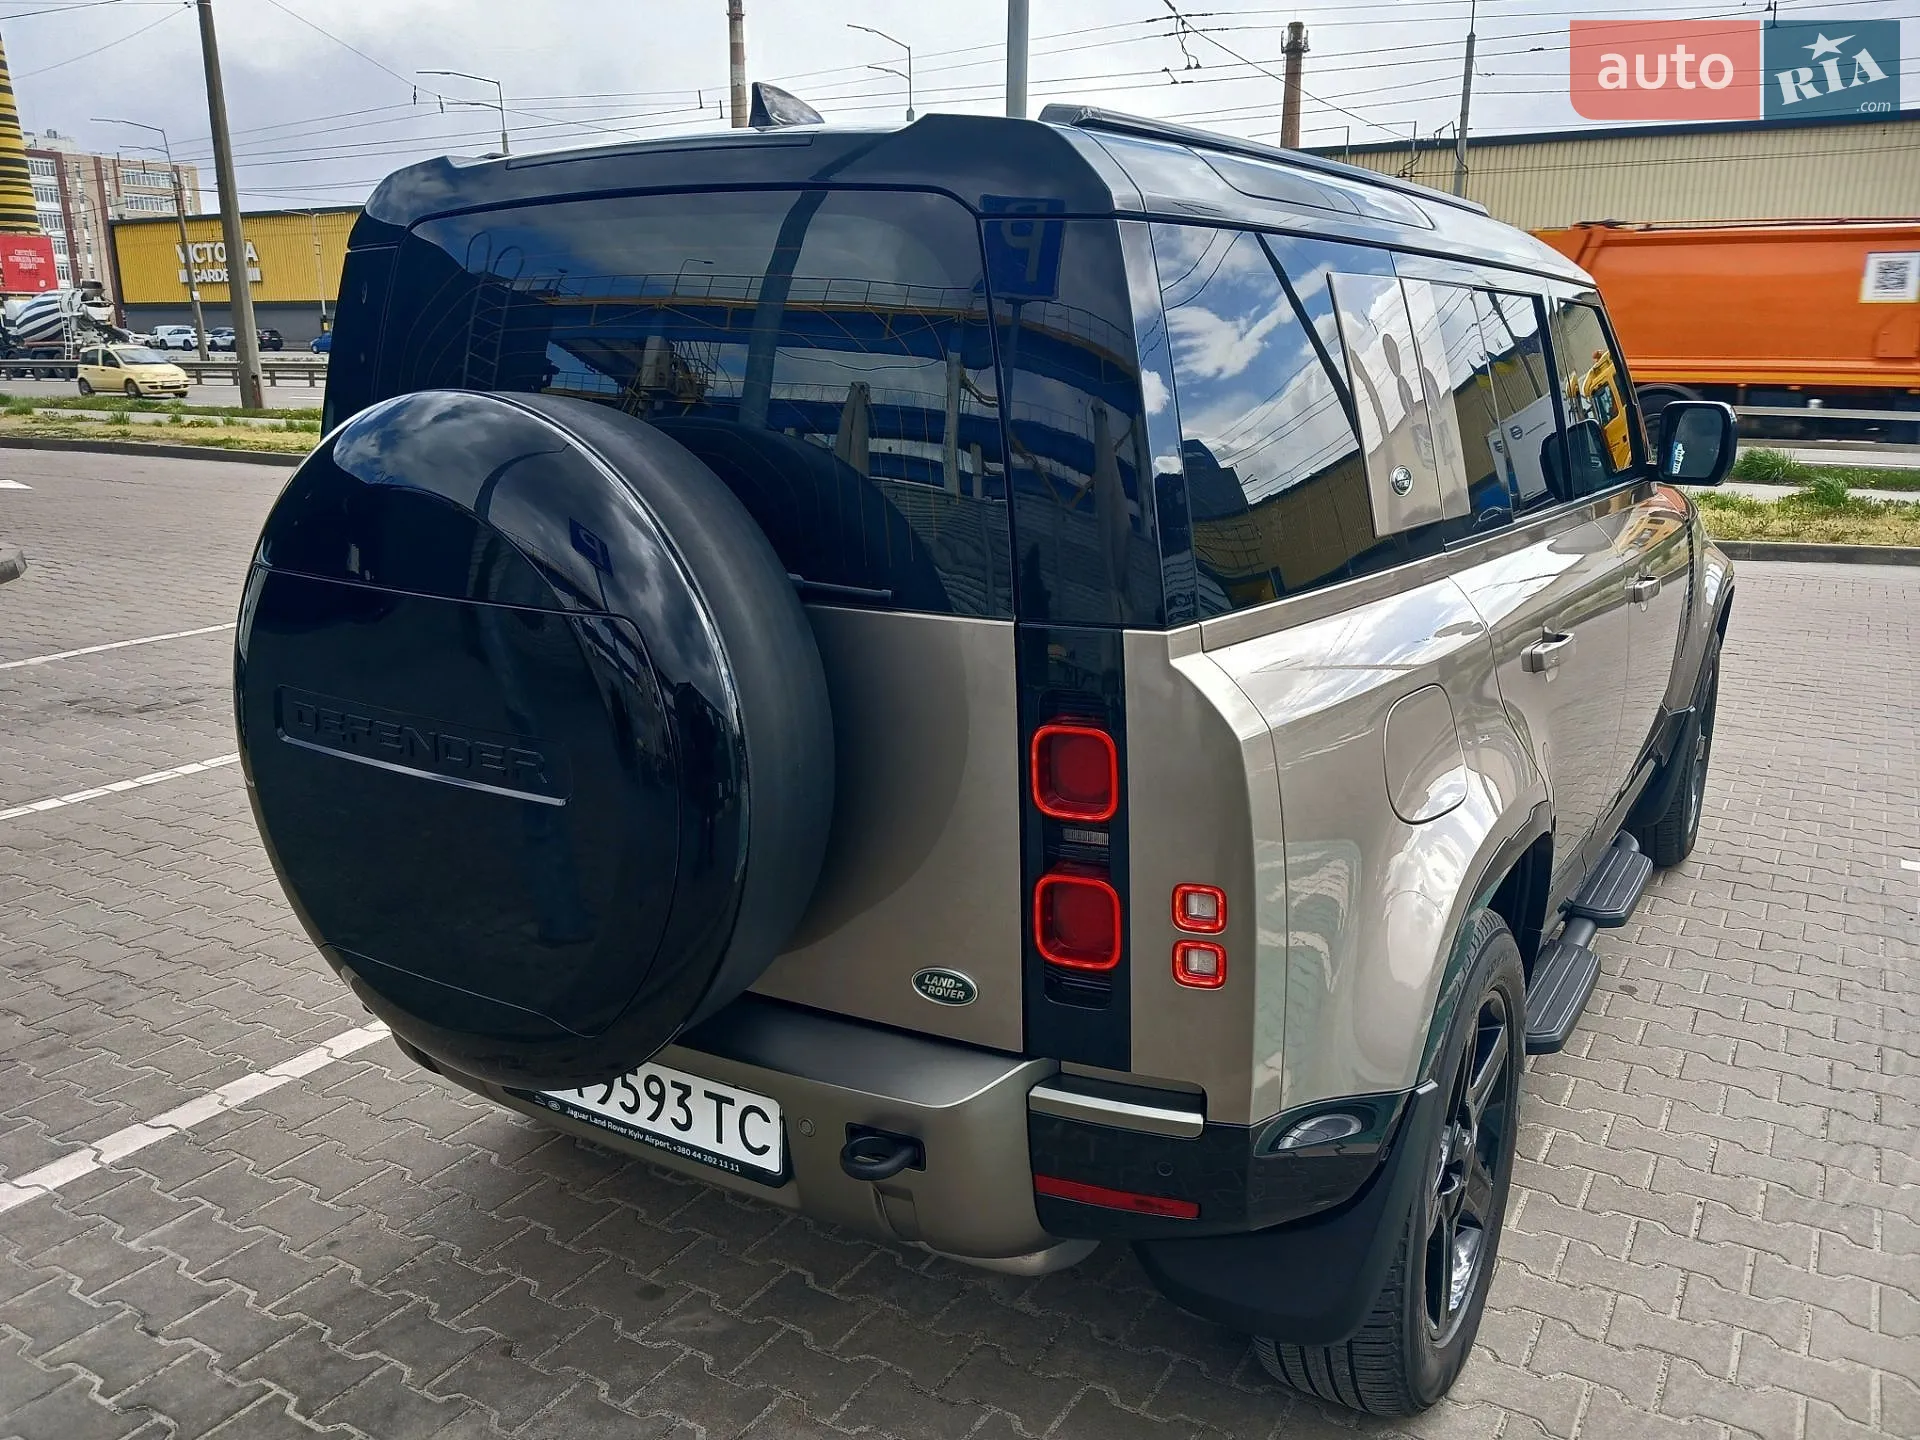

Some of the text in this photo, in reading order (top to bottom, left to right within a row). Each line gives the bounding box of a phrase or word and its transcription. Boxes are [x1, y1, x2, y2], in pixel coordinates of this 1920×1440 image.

[175, 241, 259, 264] VICTOA
[193, 268, 230, 283] GARDE
[294, 700, 548, 784] DEFENDER
[566, 1106, 740, 1173] Jaguar Land Rover Kyiv Airport, +380 44 202 11 11
